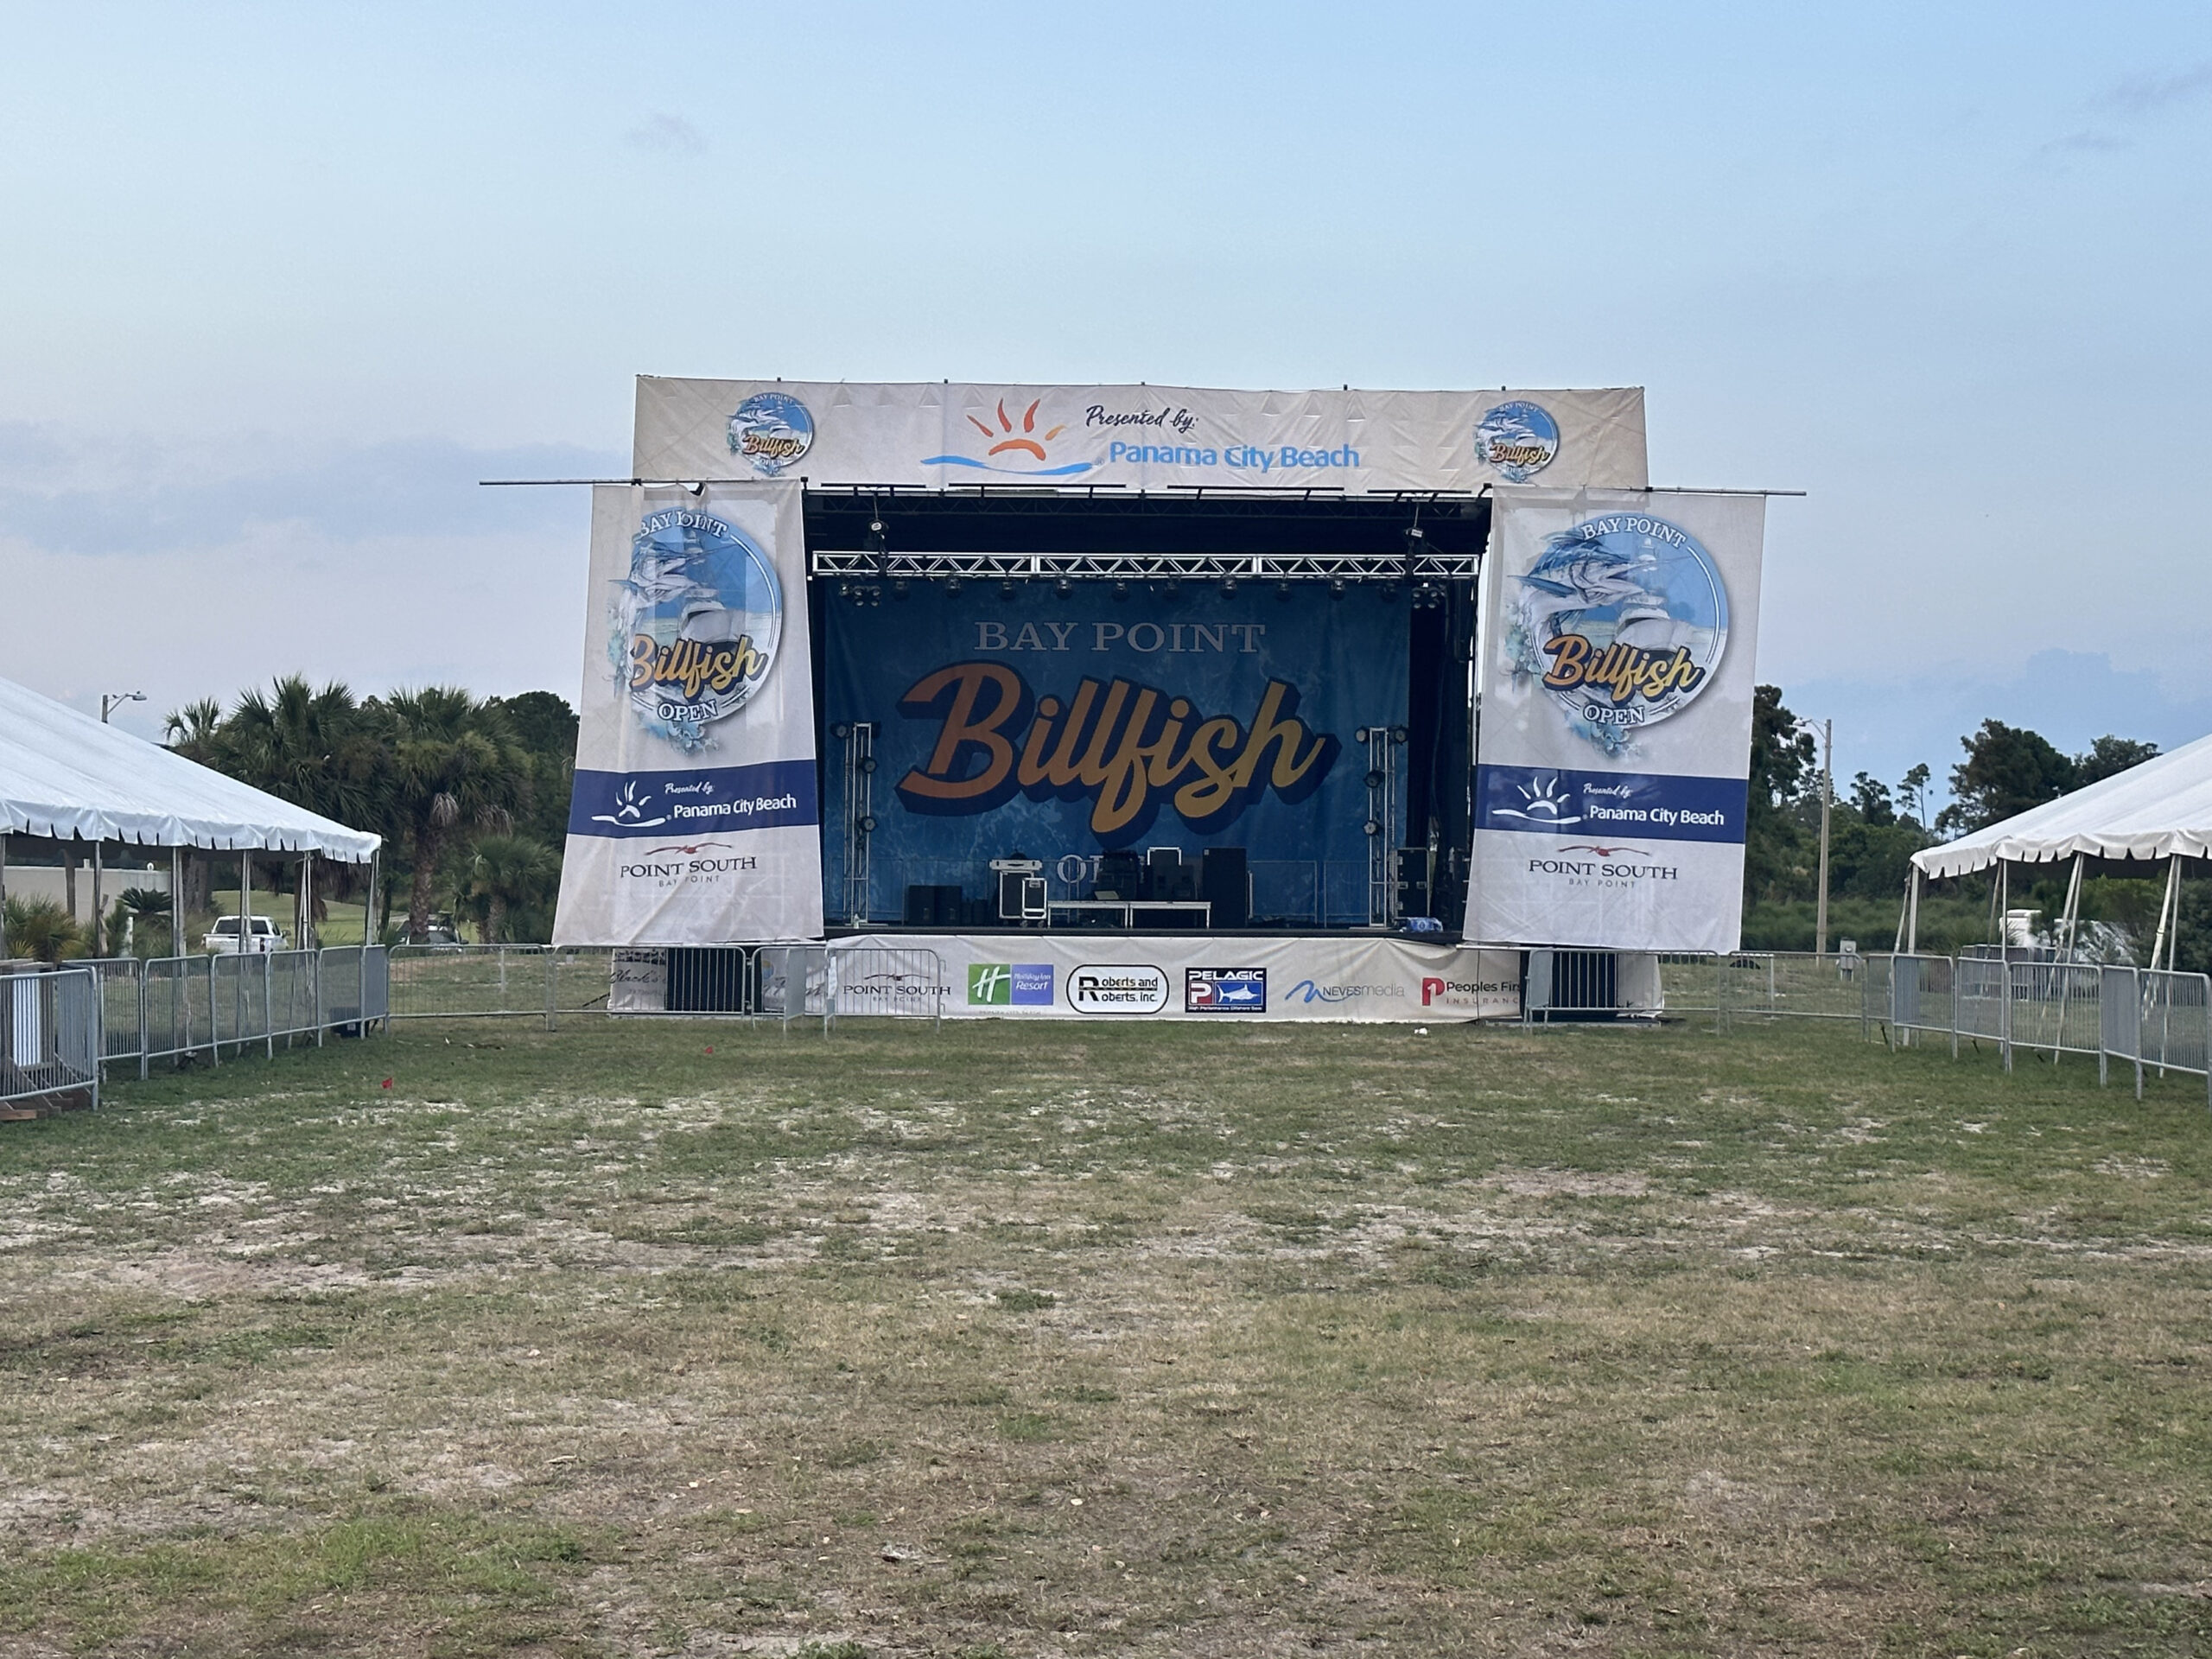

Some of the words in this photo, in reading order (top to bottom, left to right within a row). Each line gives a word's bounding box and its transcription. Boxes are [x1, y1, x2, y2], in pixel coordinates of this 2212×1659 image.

[1086, 405, 1169, 428] Presented
[1169, 408, 1199, 434] by:
[741, 435, 806, 459] Billfish
[1109, 442, 1217, 467] Panama
[1224, 444, 1276, 474] City
[1280, 443, 1360, 468] Beach
[1489, 442, 1551, 467] Billfish
[1581, 518, 1622, 541] BAY
[1625, 518, 1687, 549] POINT
[973, 620, 1079, 652] BAY
[1090, 621, 1267, 653] POINT
[628, 634, 769, 700] Billfish
[1541, 632, 1706, 706] Billfish
[658, 699, 718, 722] OPEN
[1582, 705, 1646, 726] OPEN
[896, 660, 1339, 845] Billfish
[664, 781, 702, 795] Presented
[1583, 782, 1621, 796] Presented
[673, 803, 731, 819] Panama
[733, 798, 755, 816] City
[755, 793, 797, 811] Beach
[1589, 804, 1648, 822] Panama
[1649, 807, 1679, 826] City
[1679, 809, 1725, 826] Beach
[620, 862, 685, 879] POINT
[689, 856, 758, 874] SOUTH
[1529, 859, 1597, 876] POINT
[1601, 864, 1678, 880] SOUTH
[1568, 877, 1590, 887] BAY
[1598, 879, 1637, 889] POINT
[1015, 981, 1049, 991] Resort
[1138, 976, 1159, 987] and
[1188, 970, 1264, 981] PELAGIC
[843, 985, 893, 995] POINT
[895, 985, 951, 995] SOUTH
[1446, 982, 1498, 994] Peoples
